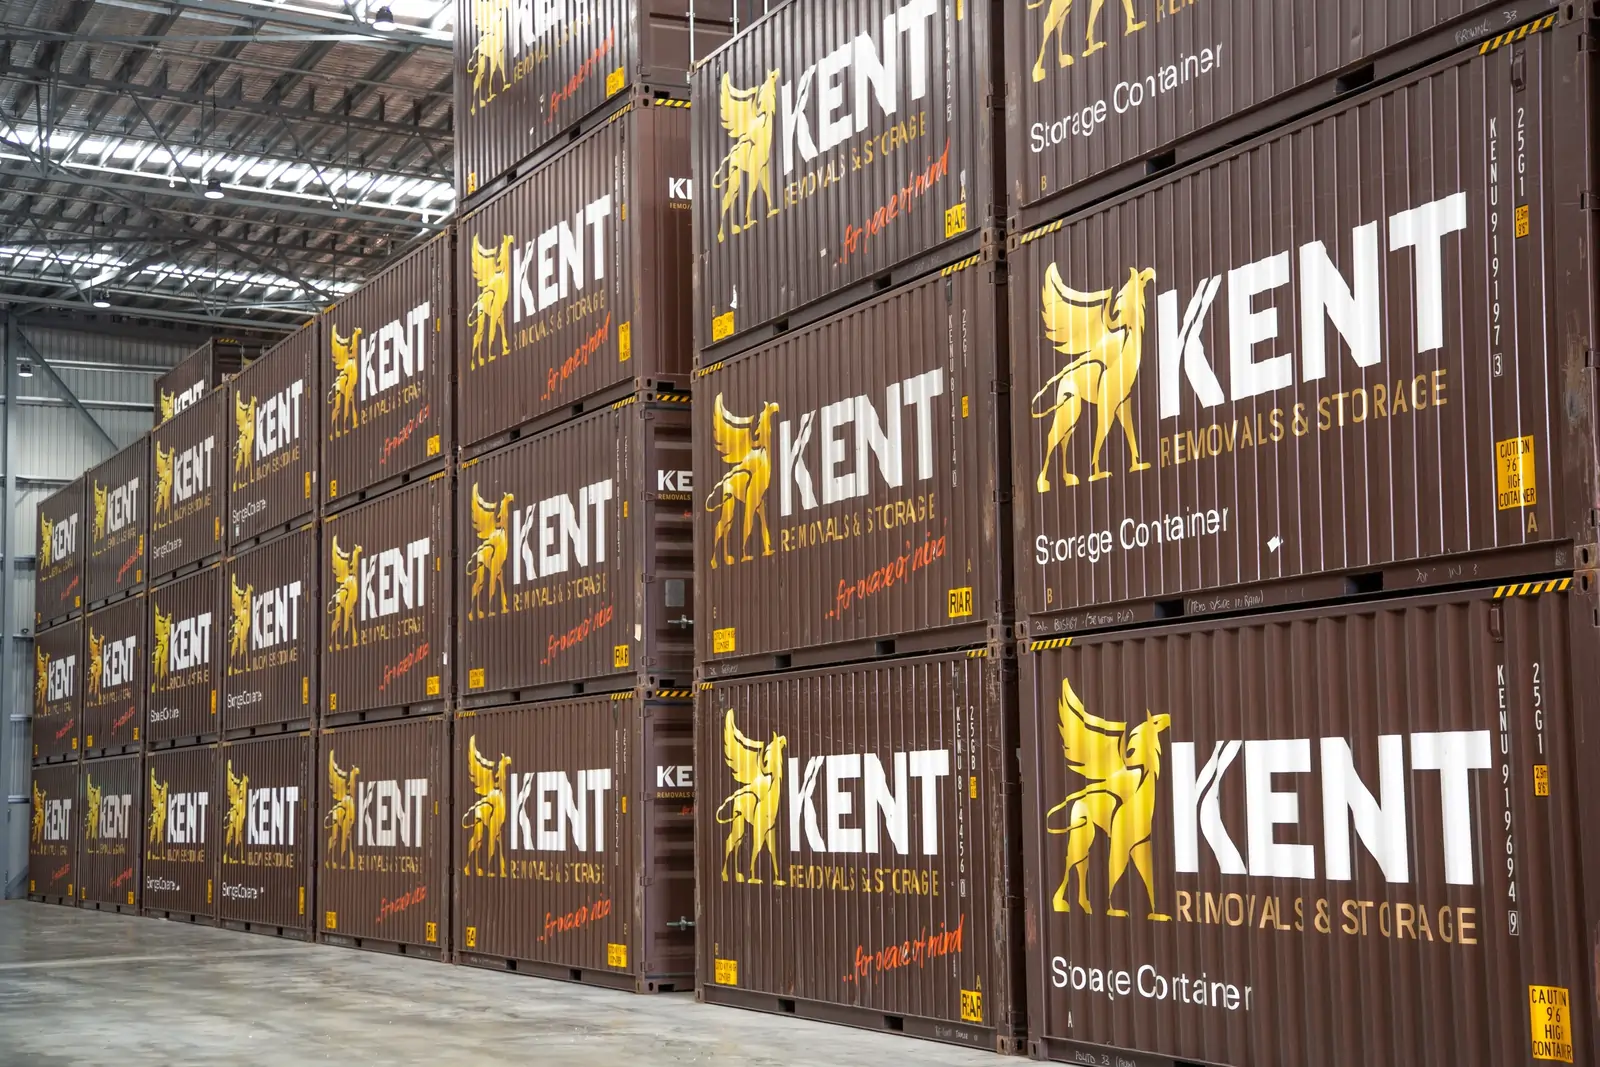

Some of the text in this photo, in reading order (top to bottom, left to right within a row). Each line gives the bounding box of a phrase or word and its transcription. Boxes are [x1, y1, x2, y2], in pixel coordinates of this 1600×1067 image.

[781, 0, 938, 175] KENT
[1031, 42, 1222, 152] Storage Container
[864, 111, 926, 165] SORAGE
[915, 137, 950, 197] mind
[1490, 116, 1498, 206] KENU
[1517, 107, 1525, 197] 25G1
[1041, 176, 1047, 191] B
[513, 194, 611, 323] KENT
[1491, 212, 1501, 346] 919197
[1158, 192, 1467, 421] KENT
[361, 301, 430, 401] KENT
[256, 379, 303, 461] KENT
[780, 366, 943, 517] KENT
[1161, 369, 1448, 468] REMOVALS & STORAGE
[174, 436, 214, 504] KENT
[107, 477, 139, 533] KENT
[513, 478, 613, 585] KENT
[780, 493, 936, 552] REMOVALS & STORAGE
[1527, 512, 1538, 533] A
[52, 513, 78, 563] KENT
[1036, 506, 1229, 566] Storage Container
[361, 537, 430, 622] KENT
[950, 590, 972, 616] RAR
[1047, 588, 1053, 603] B
[170, 612, 212, 672] KENT
[252, 581, 301, 650] KENT
[48, 655, 76, 702] KENT
[103, 635, 136, 688] KENT
[1497, 664, 1508, 754] KENU
[1532, 662, 1543, 754] 25G1
[657, 766, 692, 788] KE
[788, 750, 950, 855] KENT
[44, 799, 72, 841] KENT
[100, 794, 132, 839] KENT
[167, 792, 208, 844] KENT
[248, 786, 299, 846] KENT
[358, 778, 428, 847] KENT
[510, 768, 612, 852] KENT
[1171, 730, 1492, 886] KENT
[1502, 764, 1516, 902] 919694
[874, 868, 939, 896] SORAGE
[912, 926, 926, 968] of
[927, 913, 964, 958] mind
[1314, 898, 1331, 934] &
[1342, 900, 1478, 945] STORAGE
[1137, 964, 1252, 1011] Container
[1532, 988, 1567, 1007] CAUTN
[1068, 1011, 1073, 1028] A
